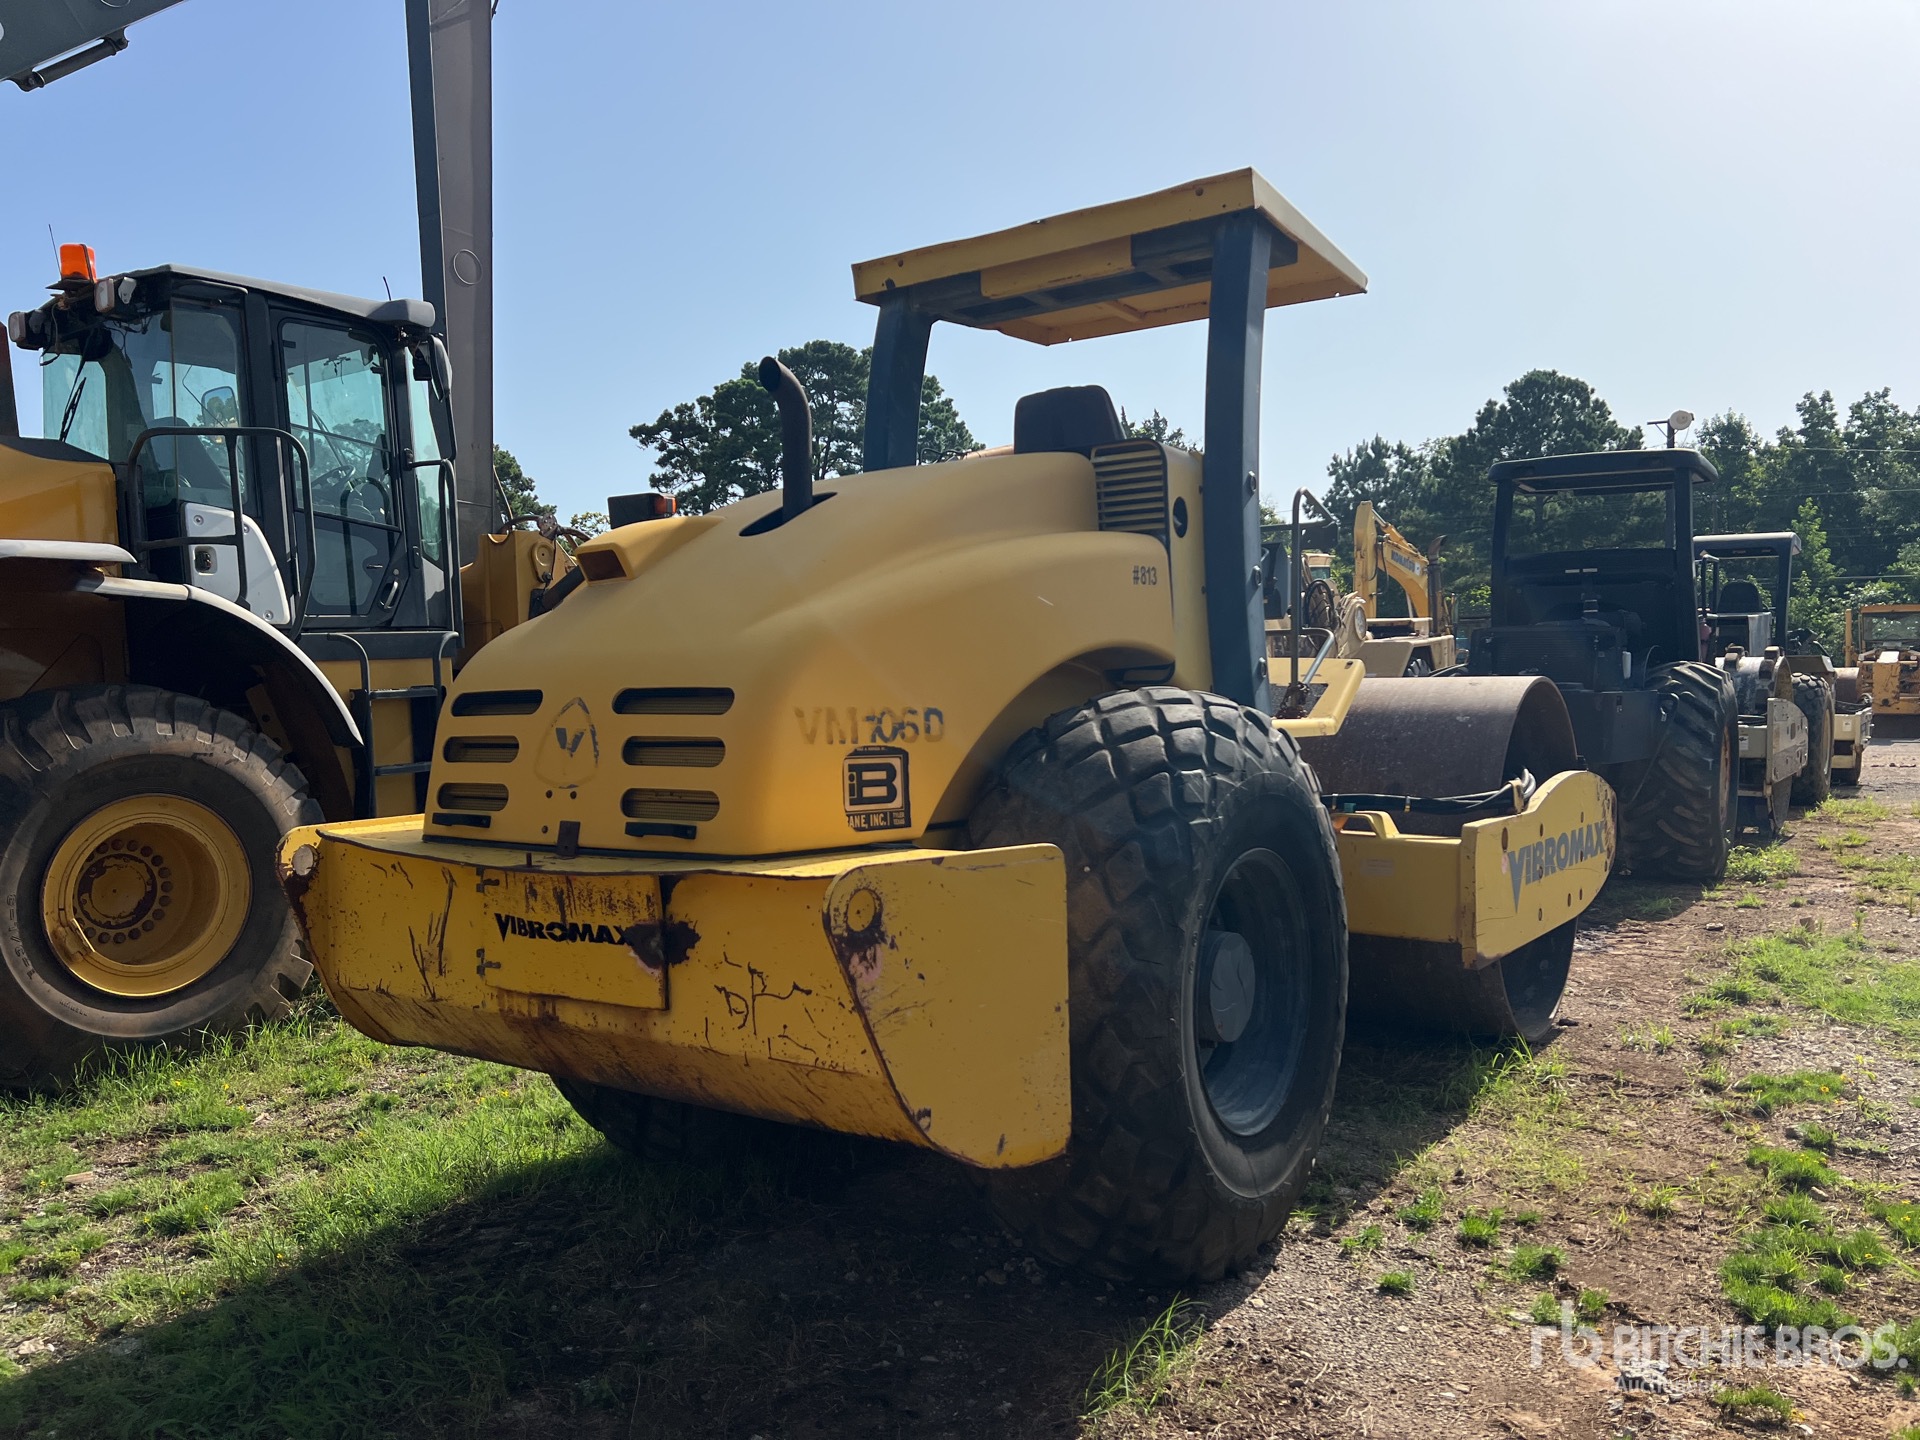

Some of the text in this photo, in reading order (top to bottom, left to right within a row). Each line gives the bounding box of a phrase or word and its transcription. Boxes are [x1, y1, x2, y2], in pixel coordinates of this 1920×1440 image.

[1132, 565, 1158, 585] #813
[869, 812, 887, 827] INC.
[1508, 820, 1605, 914] VIBROMAX
[494, 912, 634, 946] VIBROMAX
